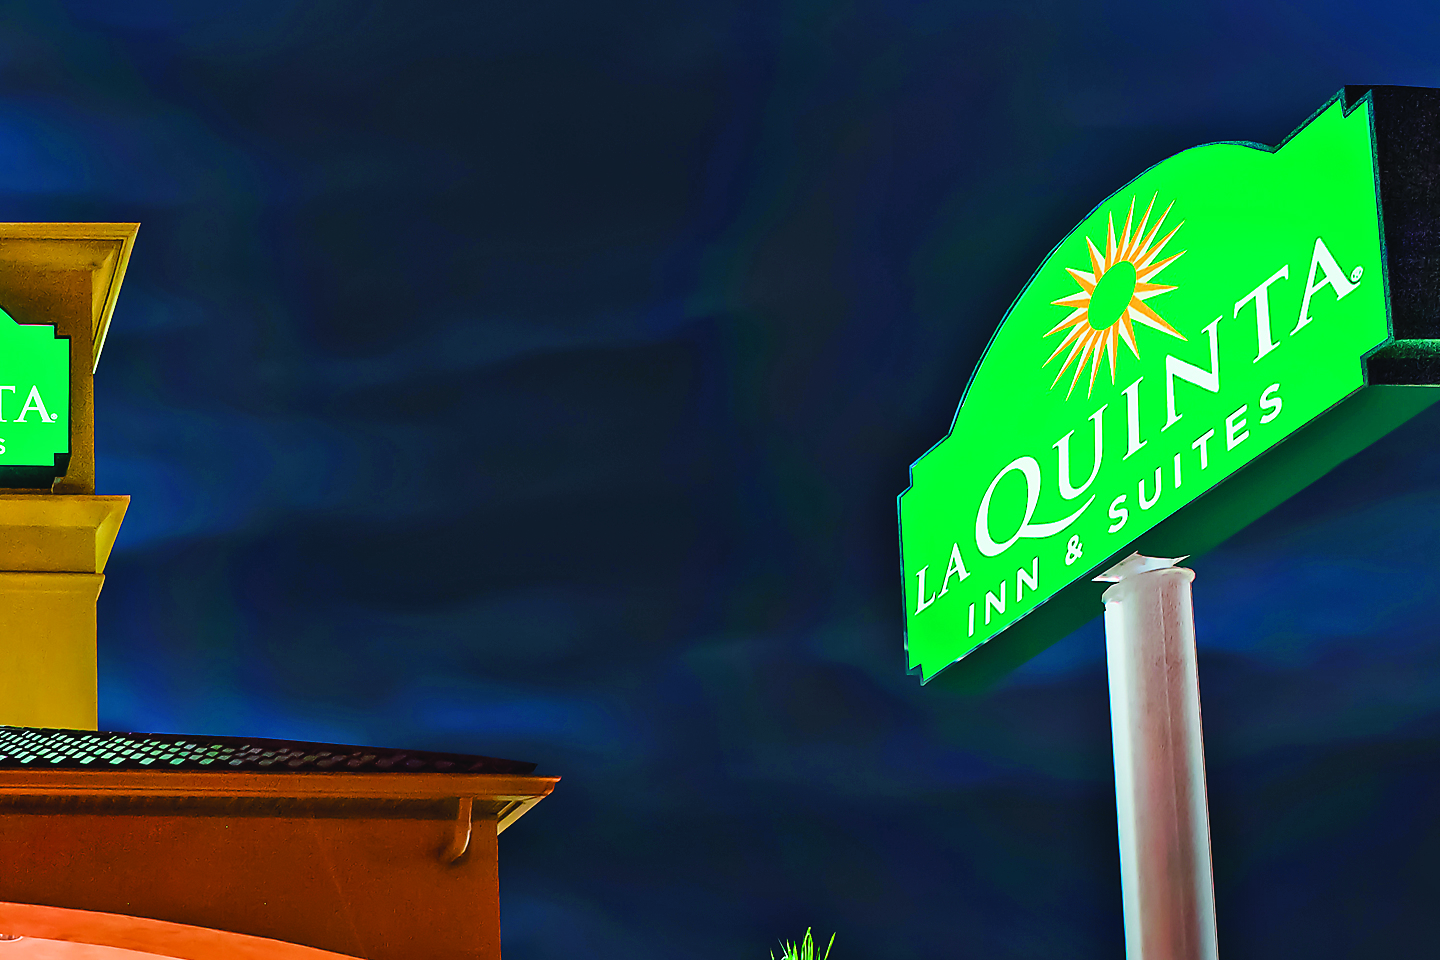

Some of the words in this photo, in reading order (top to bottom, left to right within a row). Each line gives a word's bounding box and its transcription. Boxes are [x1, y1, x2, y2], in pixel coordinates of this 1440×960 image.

[968, 556, 1039, 637] INN
[1064, 534, 1083, 566] &
[1107, 383, 1284, 535] SUITES
